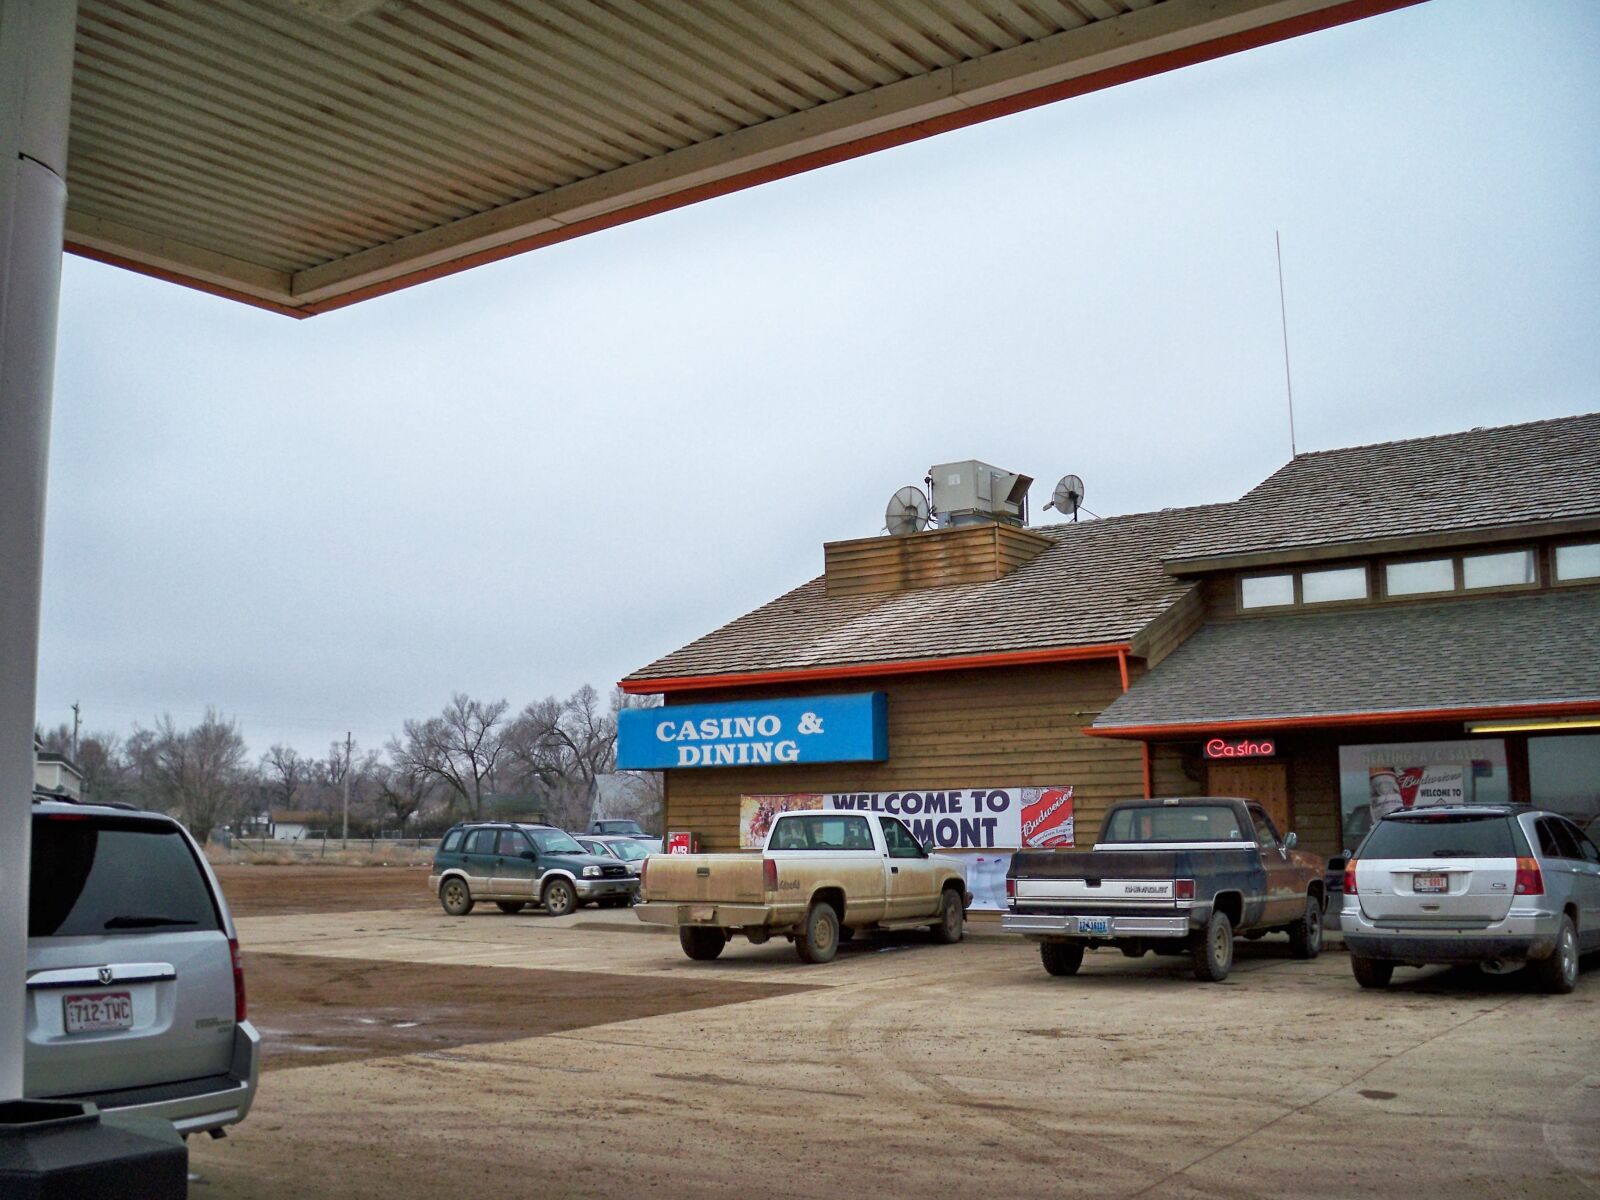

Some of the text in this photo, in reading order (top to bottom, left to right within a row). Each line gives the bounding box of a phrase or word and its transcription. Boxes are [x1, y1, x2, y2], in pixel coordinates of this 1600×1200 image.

[656, 712, 824, 742] CASINO &
[678, 741, 800, 766] DINING
[1207, 739, 1273, 757] Casino
[1400, 773, 1462, 788] Budweiser
[1420, 788, 1462, 797] WELCOME TO
[832, 791, 962, 814] WELCOME
[971, 790, 1010, 812] TO
[1021, 786, 1073, 837] Budweiser
[902, 818, 997, 847] MONT
